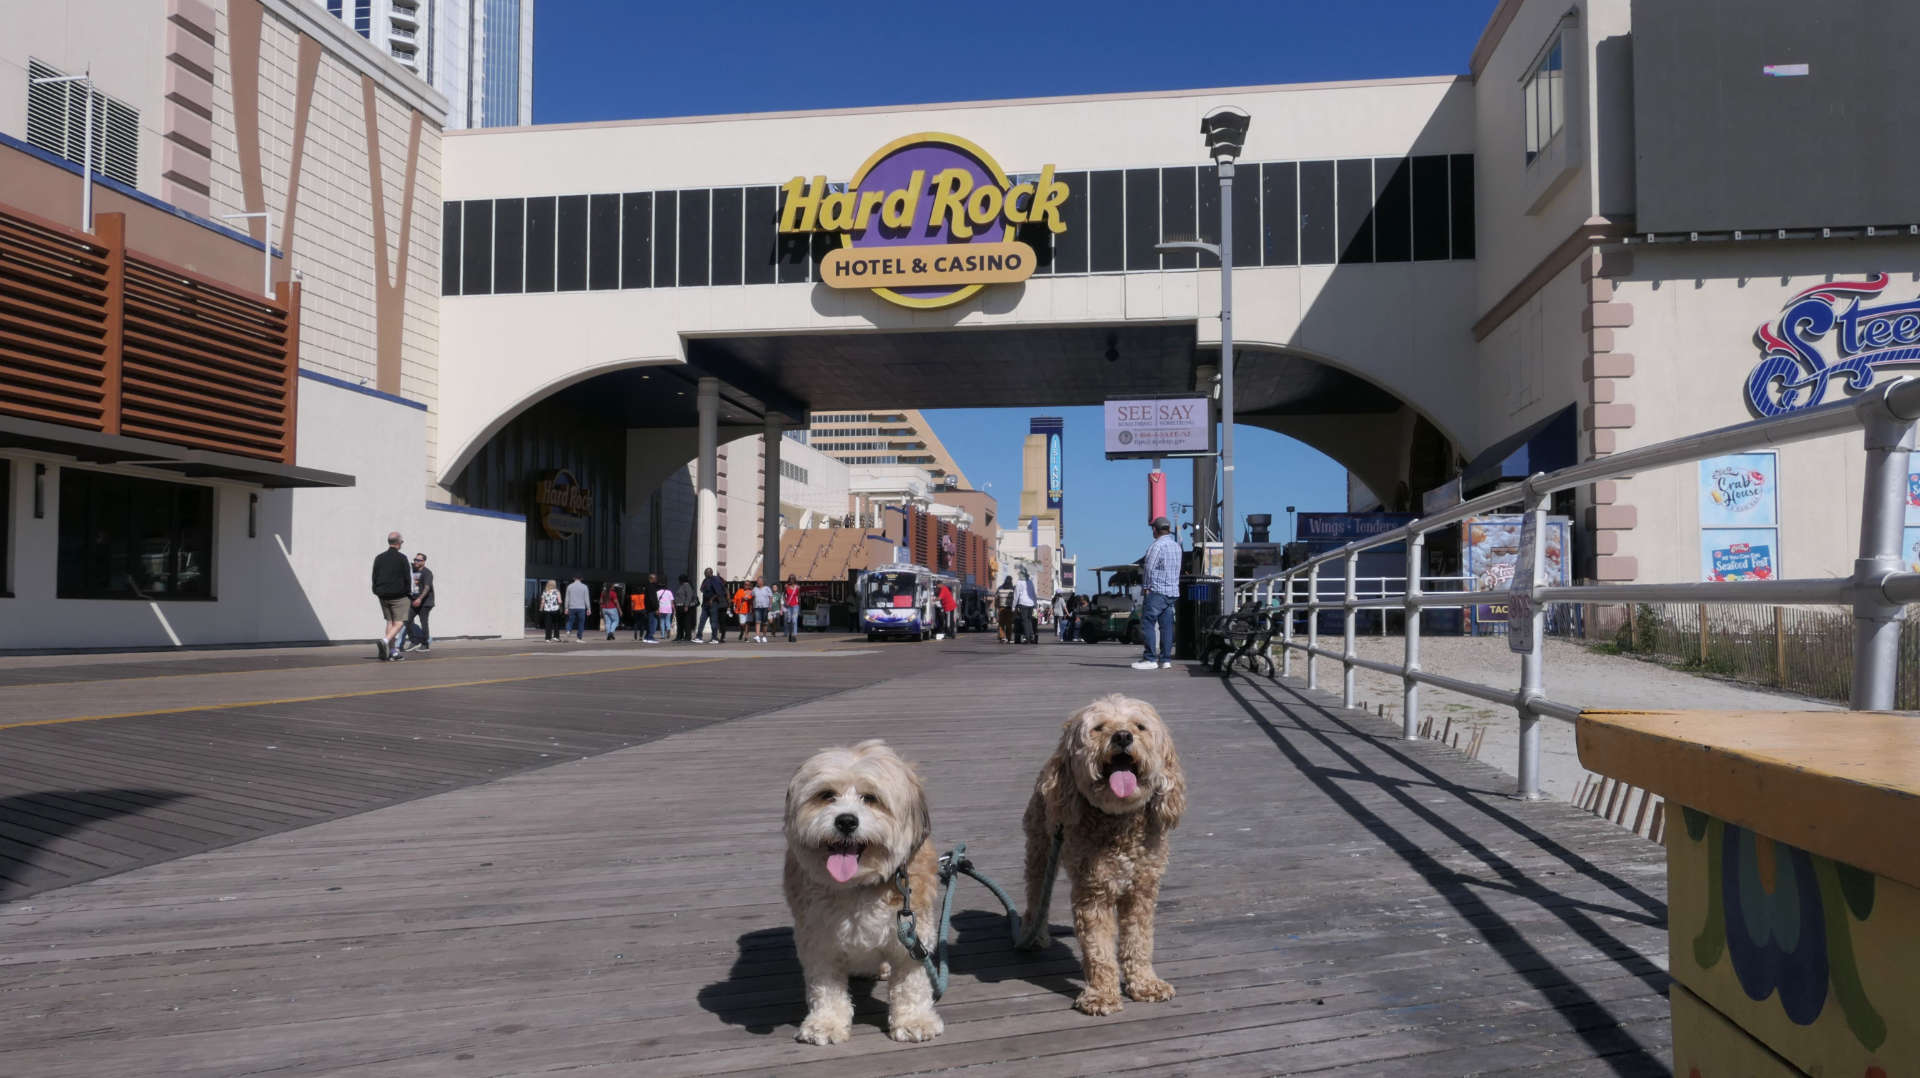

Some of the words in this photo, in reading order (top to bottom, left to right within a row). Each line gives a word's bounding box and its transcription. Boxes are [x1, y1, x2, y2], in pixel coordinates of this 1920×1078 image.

[778, 170, 926, 233] Hard
[929, 164, 1071, 239] Rock
[835, 258, 906, 277] HOTEL
[912, 257, 928, 273] &
[934, 254, 1022, 273] CASINO
[1117, 405, 1153, 421] SEE
[1159, 404, 1194, 420] SAY
[1718, 474, 1751, 491] Crab
[1723, 489, 1760, 507] House
[1309, 519, 1345, 536] Wings
[1716, 559, 1748, 571] Seafood
